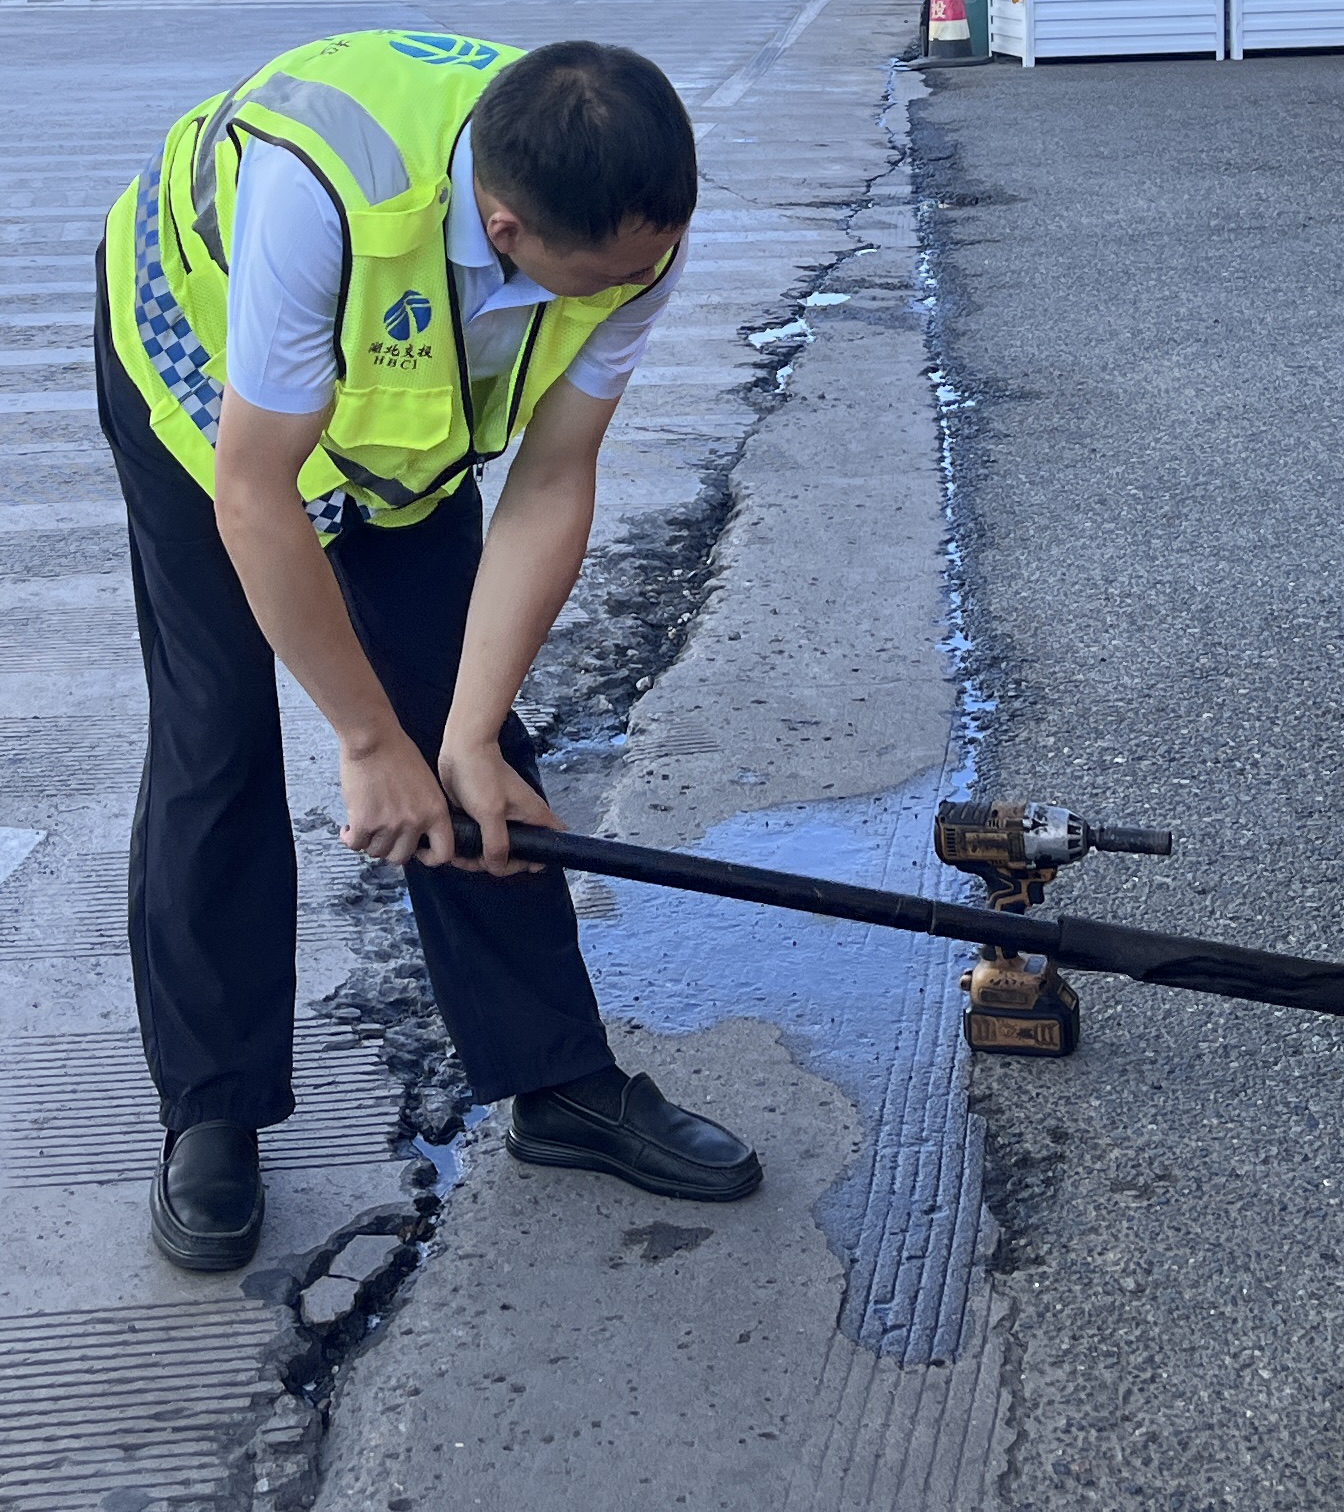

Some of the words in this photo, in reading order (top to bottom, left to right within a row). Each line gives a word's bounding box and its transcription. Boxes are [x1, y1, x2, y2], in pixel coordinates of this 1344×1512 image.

[368, 341, 433, 358] 湖北交投
[373, 355, 418, 370] HBCI
